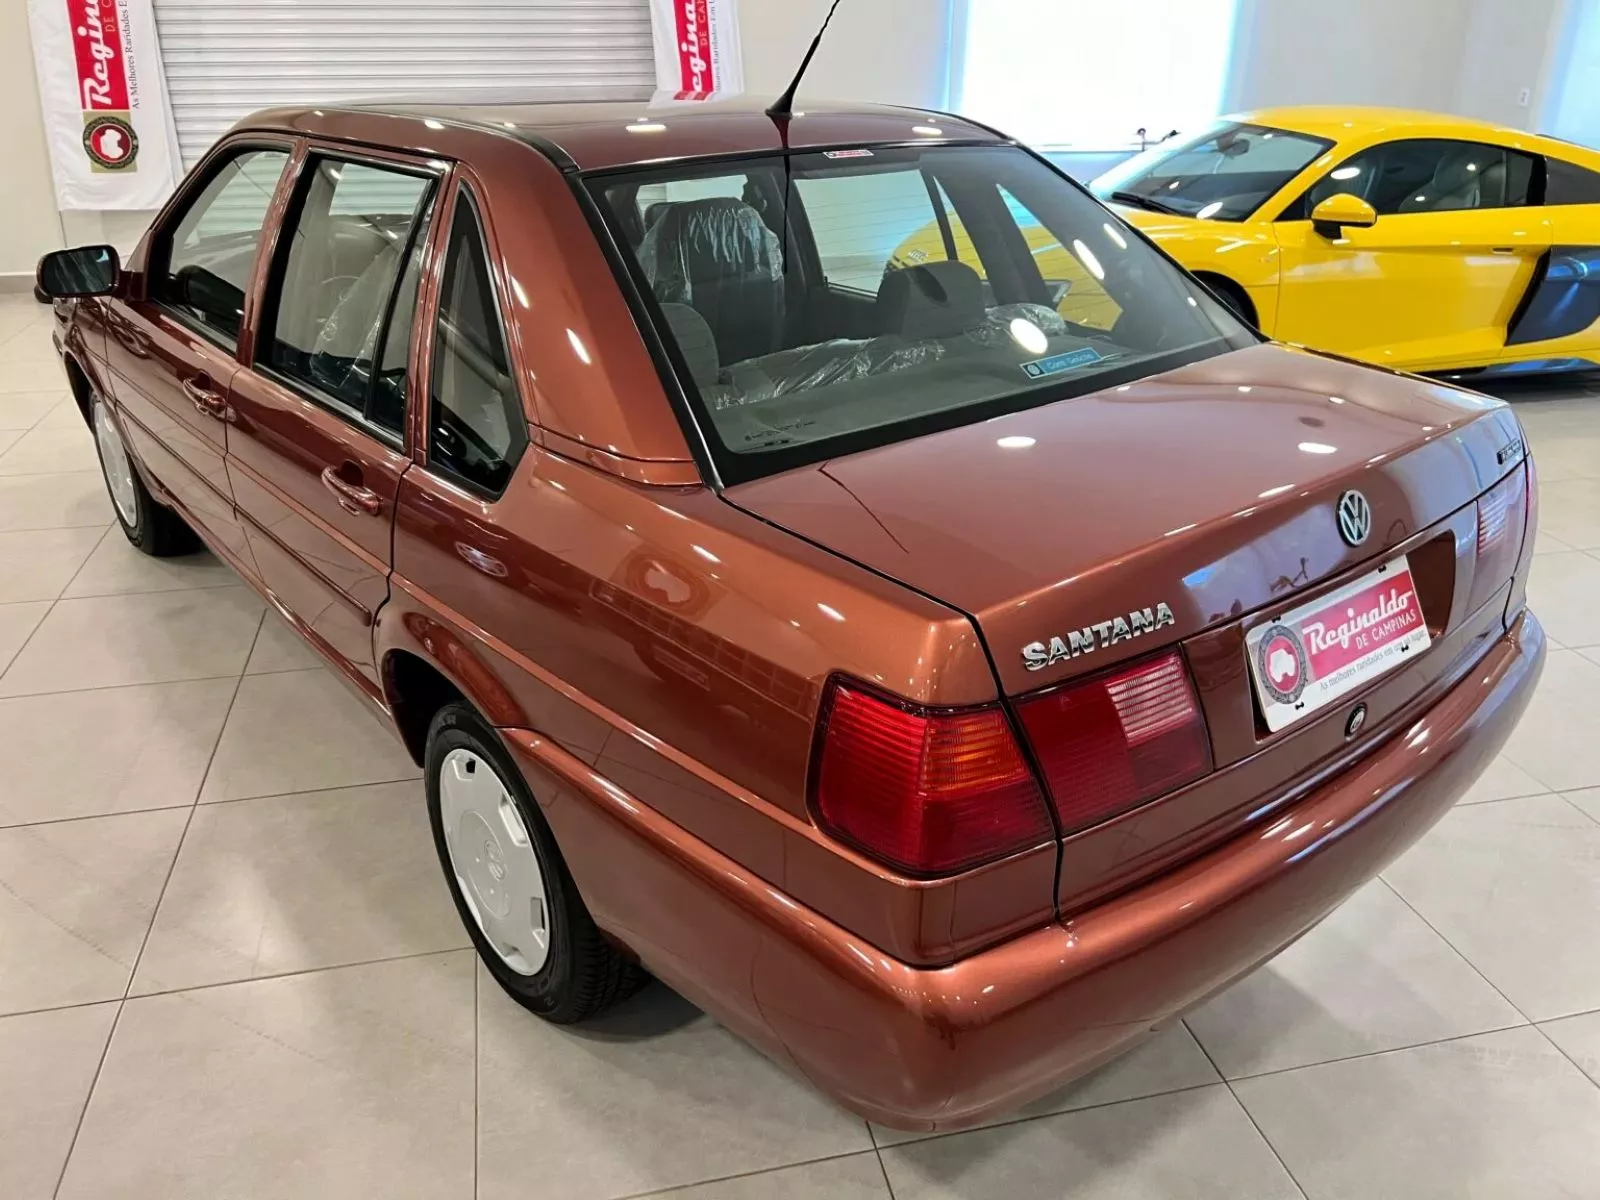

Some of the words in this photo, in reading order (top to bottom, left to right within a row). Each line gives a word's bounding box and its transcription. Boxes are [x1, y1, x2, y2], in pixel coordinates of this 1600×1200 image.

[103, 16, 116, 32] DE
[121, 9, 133, 53] Raridades
[698, 31, 708, 46] DE
[127, 55, 138, 96] Melhores
[132, 98, 140, 109] As
[1021, 602, 1175, 671] SANTANA
[1301, 588, 1413, 655] Reginaldo
[1355, 632, 1369, 650] DE
[1371, 608, 1416, 641] CAMPINAS
